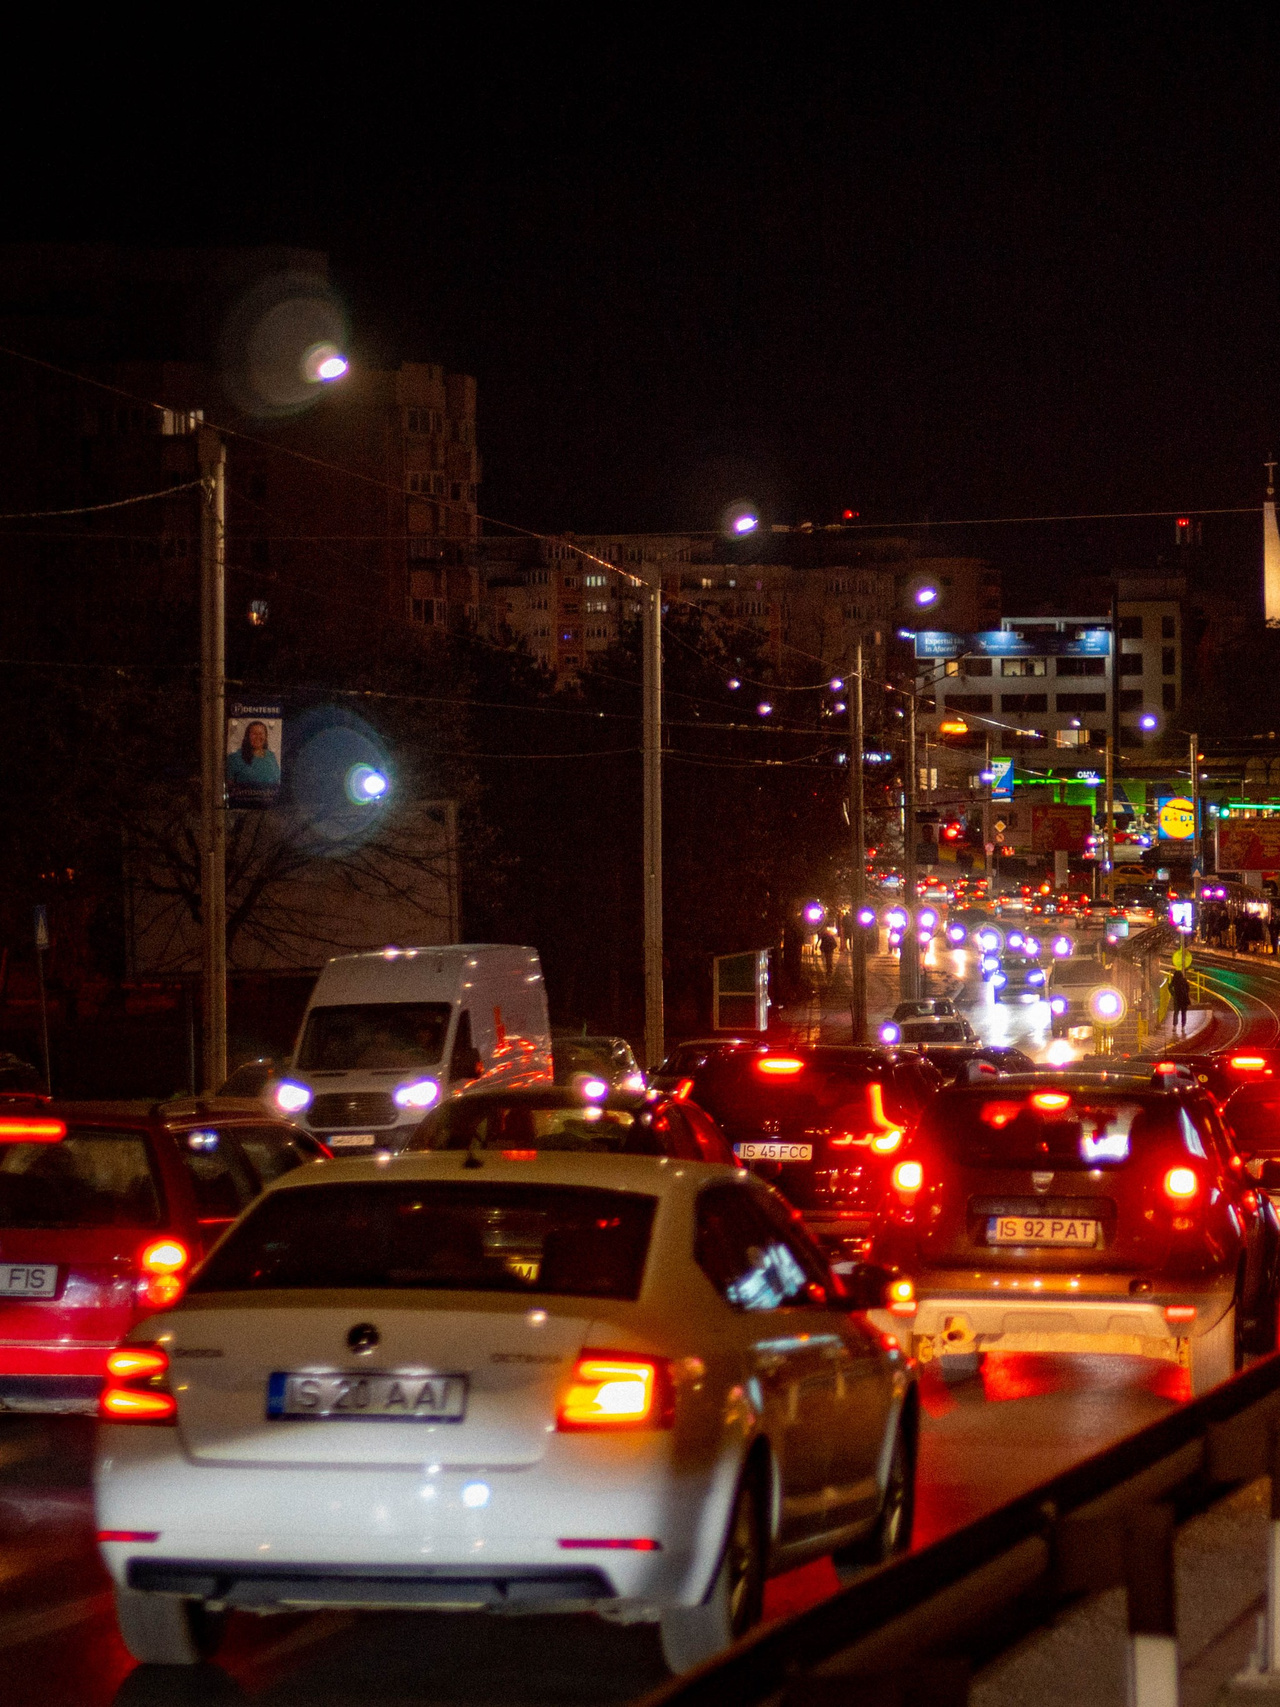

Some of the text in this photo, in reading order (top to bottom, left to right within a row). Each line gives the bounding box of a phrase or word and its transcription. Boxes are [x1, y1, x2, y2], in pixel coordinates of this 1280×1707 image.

[1077, 771, 1096, 779] OMV
[743, 1145, 808, 1158] IS 45 FCC
[1000, 1220, 1091, 1239] IS 92 PAT
[9, 1268, 46, 1289] FIS
